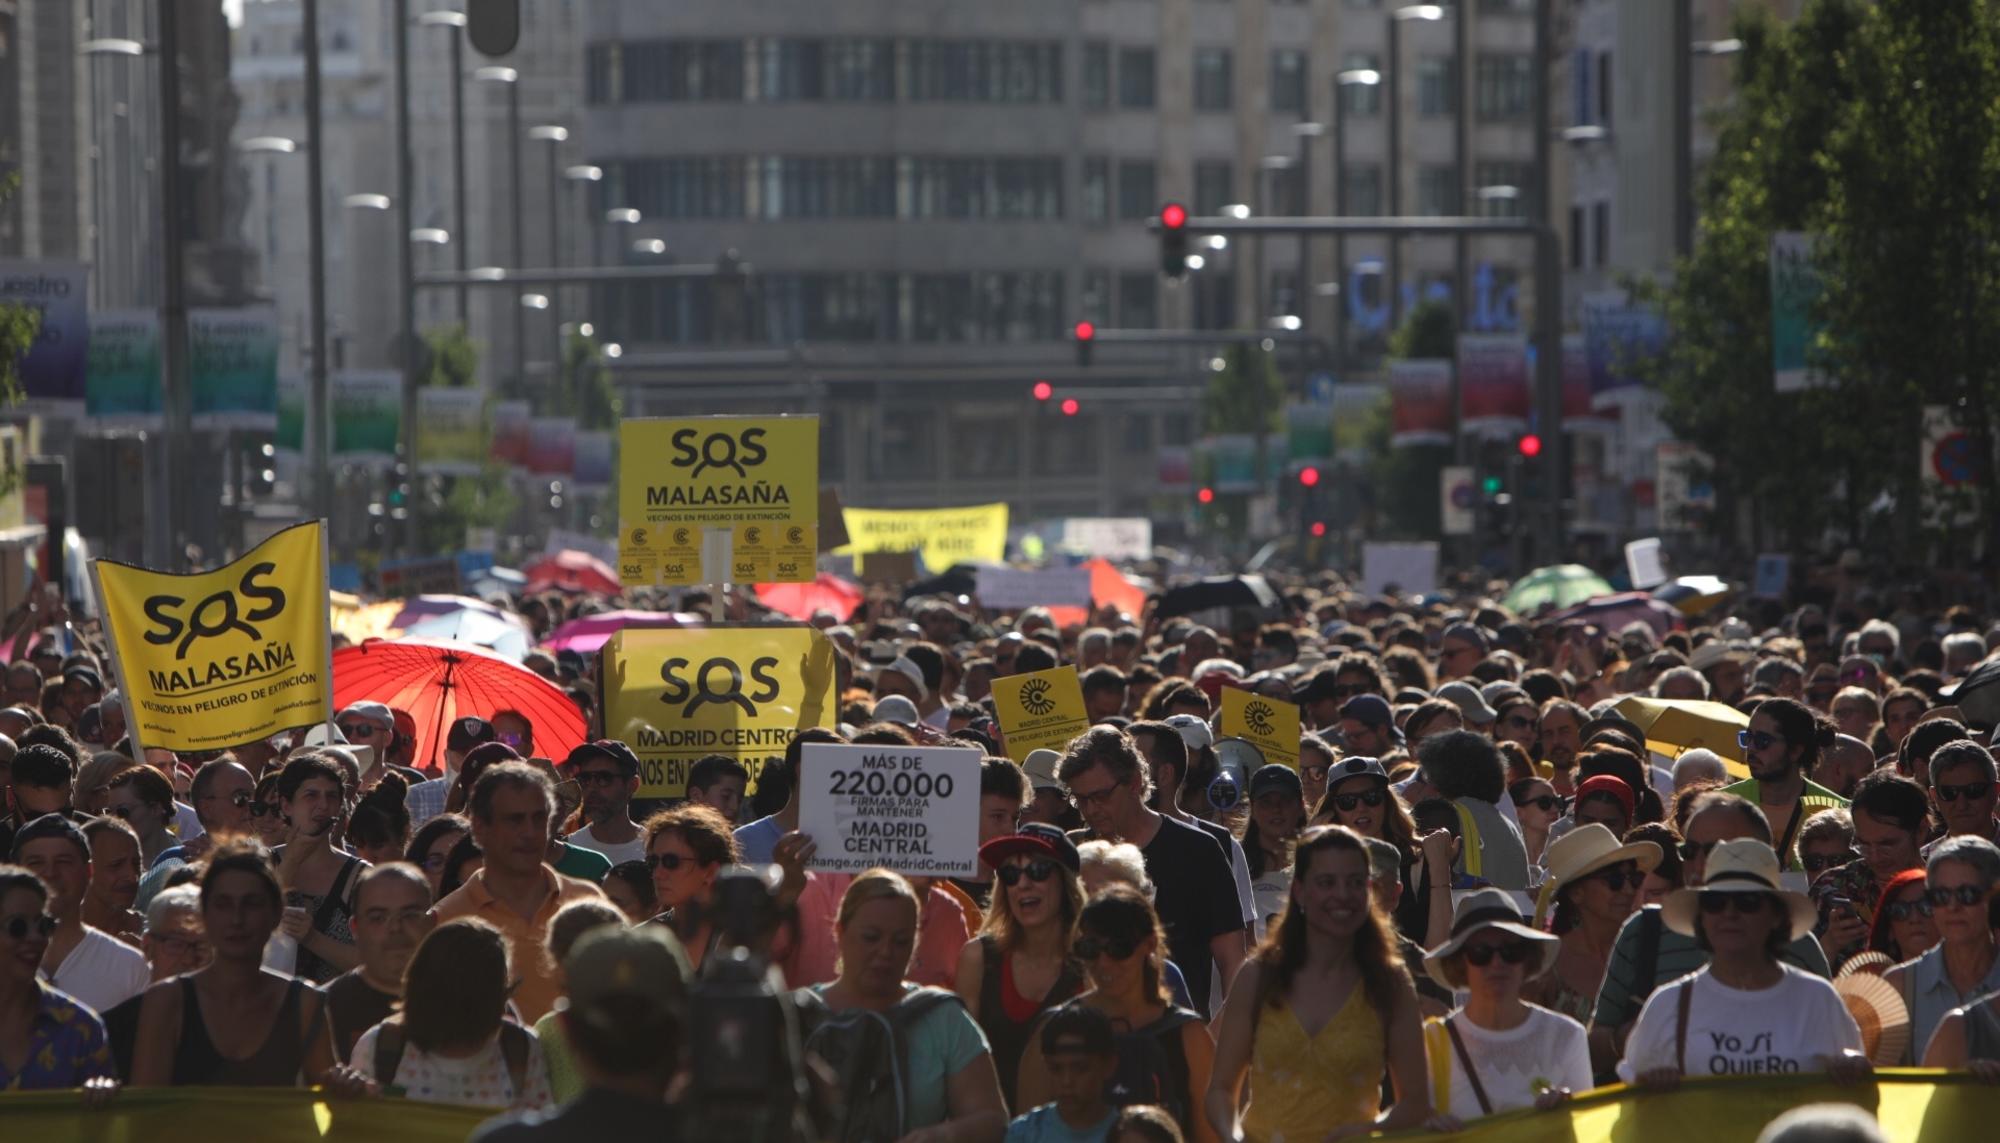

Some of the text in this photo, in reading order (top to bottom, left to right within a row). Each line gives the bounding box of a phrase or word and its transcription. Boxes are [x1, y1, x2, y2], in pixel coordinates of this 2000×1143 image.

[670, 428, 767, 479] SOS
[646, 481, 790, 506] MALASAÑA
[646, 511, 790, 522] VECINOS EN PELIGRO DE EXTINCIÓN
[144, 562, 286, 660] SOS
[148, 641, 295, 693] MALASAÑA
[141, 671, 318, 716] VECINOS EN PELIGRO DE EXTINCIÓN
[660, 656, 780, 719] SOS
[1018, 713, 1069, 729] MADRID CENTRAL
[637, 729, 718, 748] MADRID
[1008, 736, 1017, 744] EN
[1018, 731, 1043, 743] PELIGRO
[1044, 730, 1052, 738] DE
[862, 753, 923, 770] MÁS DE
[667, 759, 685, 785] EN
[829, 771, 954, 798] 220.000
[851, 796, 930, 808] FIRMAS PARA
[856, 806, 924, 818] MANTENER
[851, 821, 927, 838] MADRID
[844, 838, 933, 855] CENTRAL
[1710, 1031, 1741, 1053] Yo
